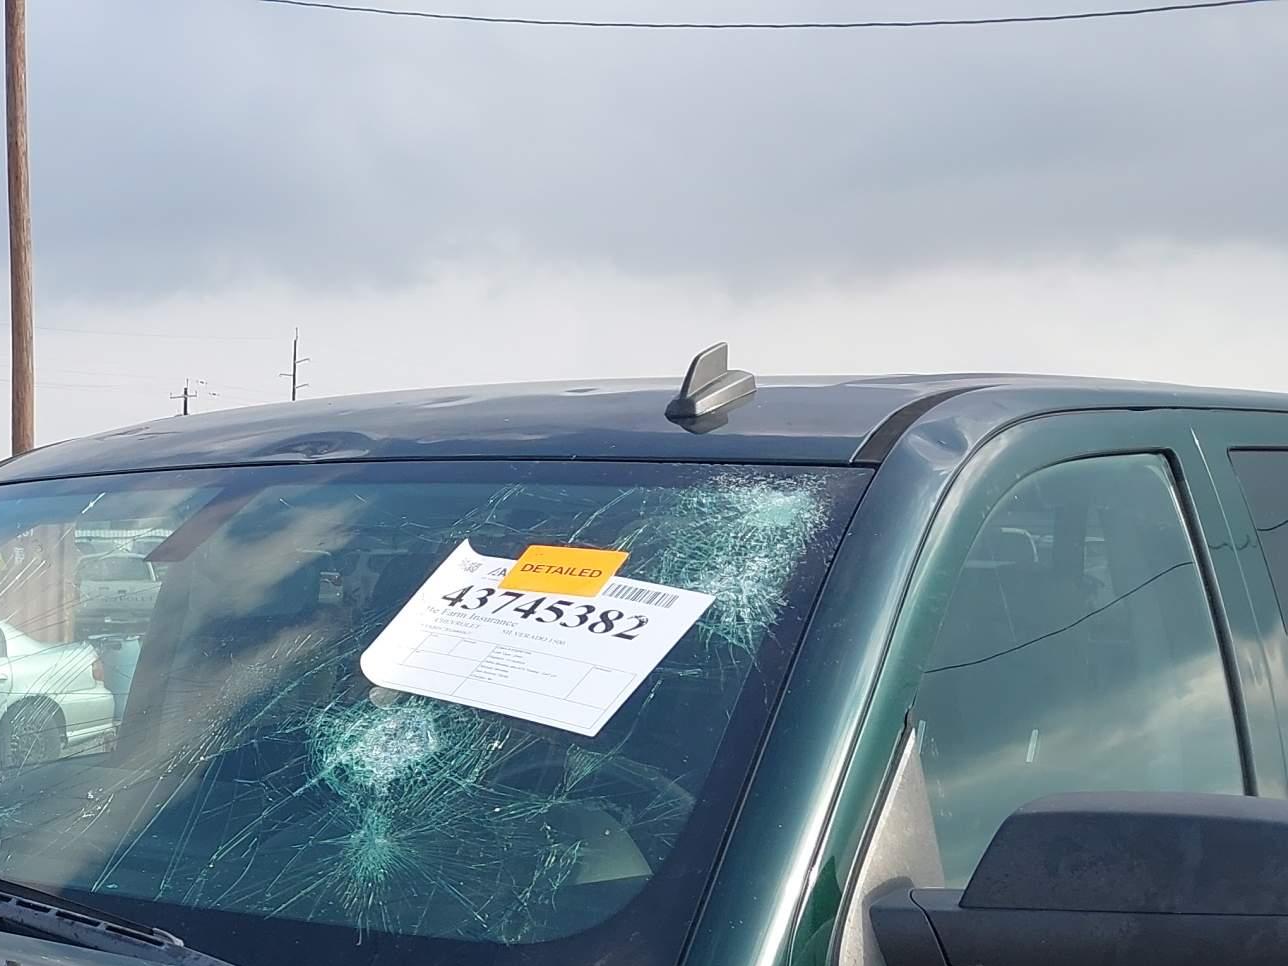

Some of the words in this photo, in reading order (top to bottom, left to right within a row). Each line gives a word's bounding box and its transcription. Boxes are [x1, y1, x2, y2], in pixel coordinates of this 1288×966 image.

[520, 563, 603, 580] DETAILED
[441, 584, 650, 641] 43745382
[441, 608, 467, 619] Farm
[469, 612, 519, 628] Insurance
